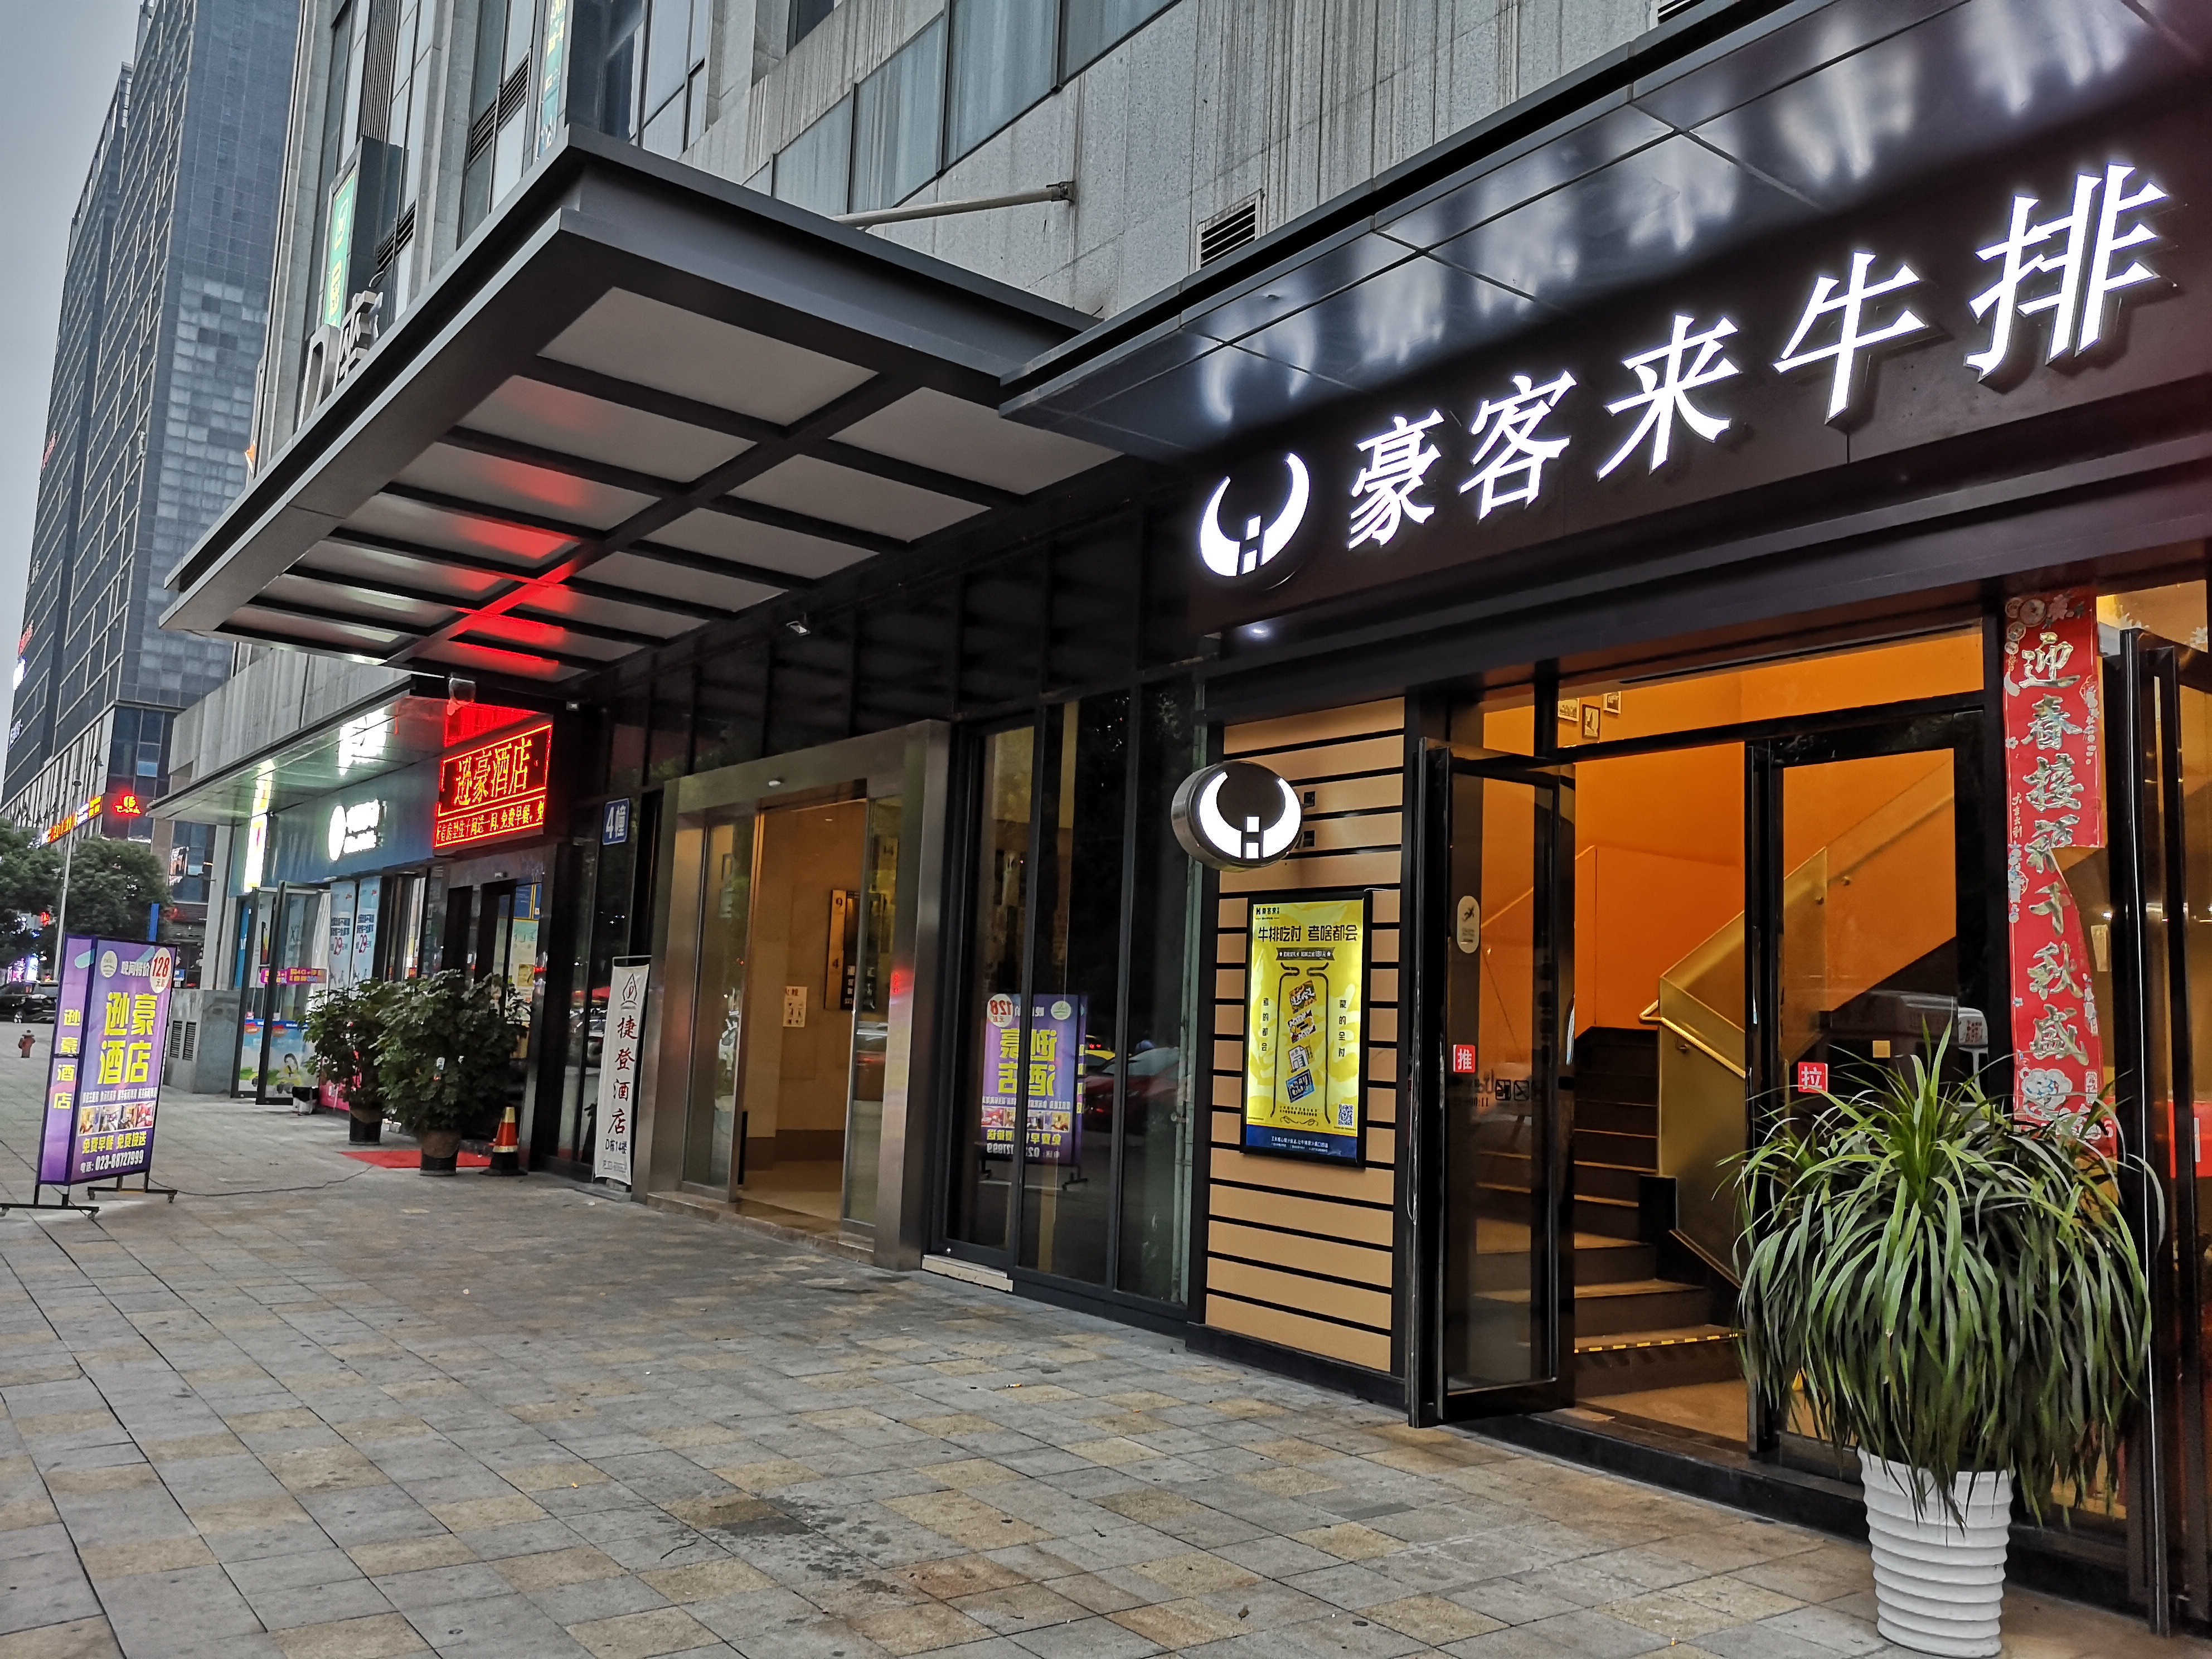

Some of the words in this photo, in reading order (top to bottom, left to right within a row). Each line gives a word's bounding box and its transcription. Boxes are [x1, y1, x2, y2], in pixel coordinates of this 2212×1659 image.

[1348, 163, 2170, 551] 豪客来牛排
[1258, 925, 1302, 942] 牛排吃对
[1307, 924, 1359, 942] 考啥都会
[152, 957, 170, 978] 128
[104, 992, 158, 1036] 逊豪
[54, 1009, 80, 1109] 逊豪酒店
[97, 1040, 152, 1085] 酒店
[608, 1015, 638, 1135] 捷登酒店
[1458, 1048, 1472, 1071] 推
[1801, 1065, 1823, 1090] 拉
[82, 1134, 114, 1154] 免费早餐
[117, 1131, 147, 1149] 免费接送
